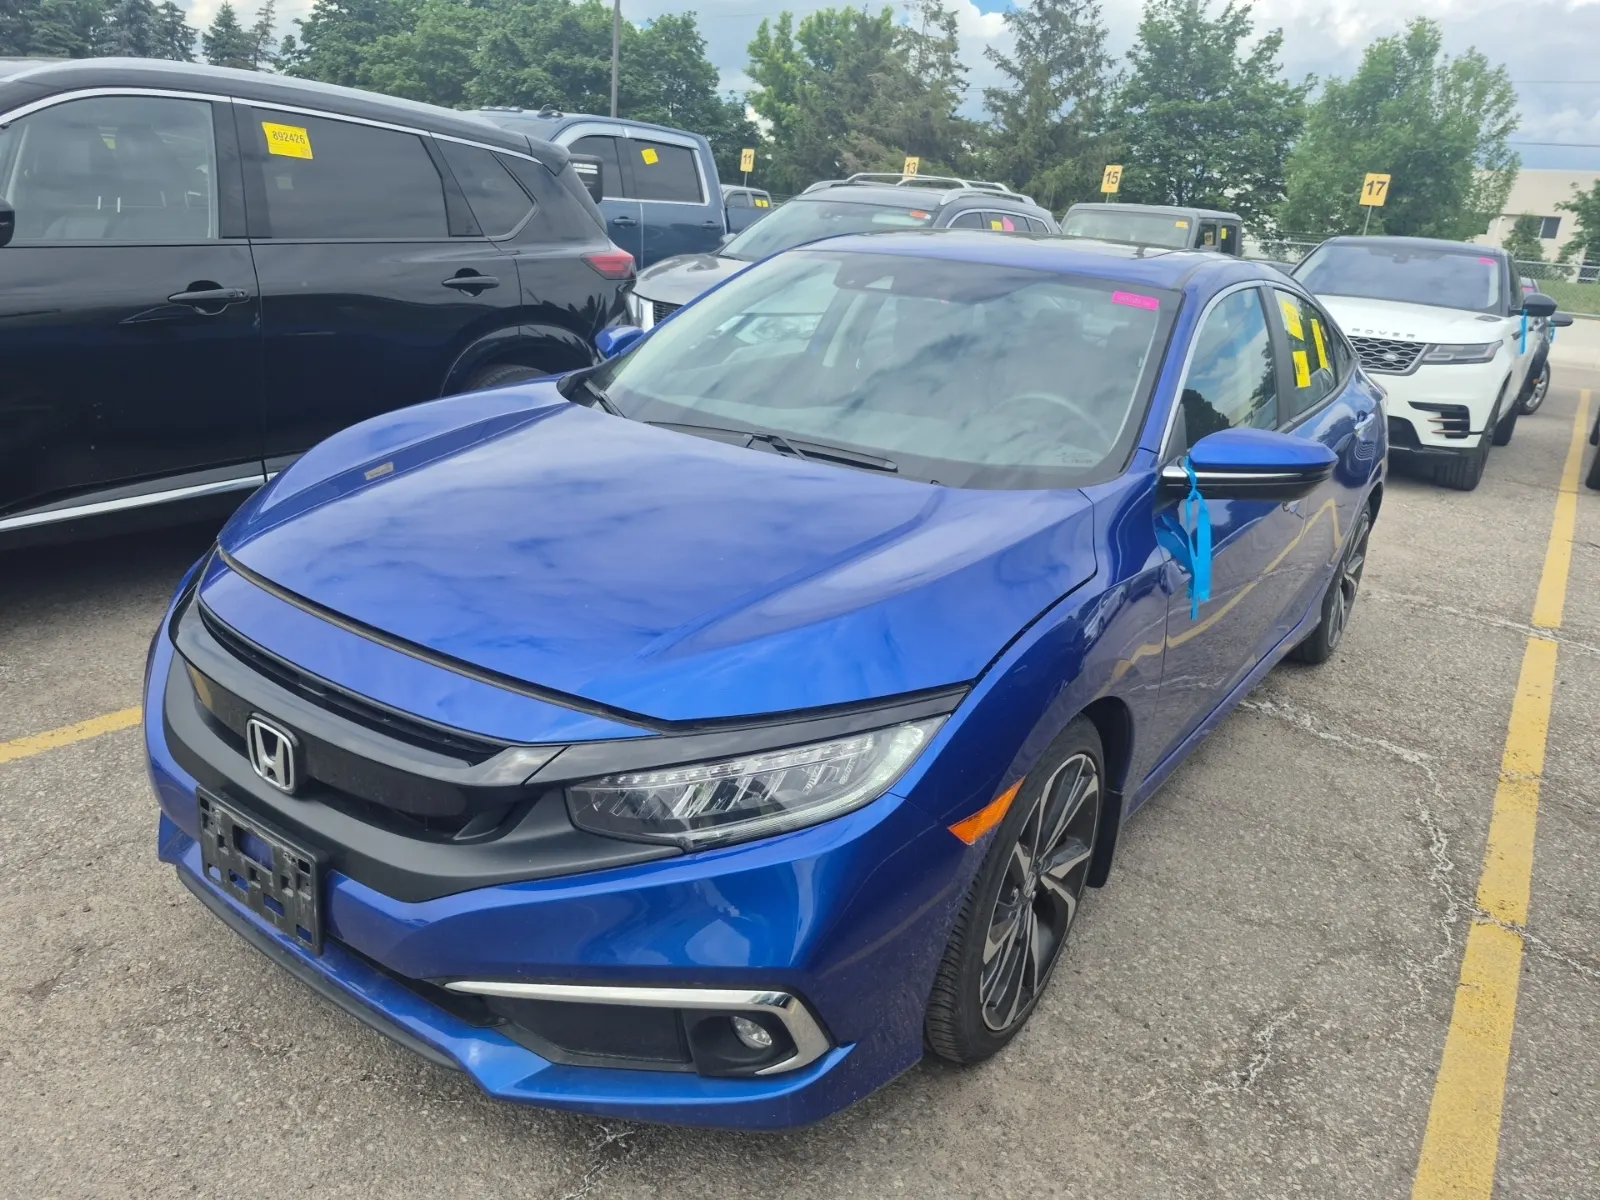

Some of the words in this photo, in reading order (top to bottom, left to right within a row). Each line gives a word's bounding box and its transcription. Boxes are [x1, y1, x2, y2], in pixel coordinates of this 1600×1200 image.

[743, 153, 752, 165] 11
[906, 162, 916, 175] 13
[1106, 171, 1119, 185] 15
[1366, 180, 1387, 196] 17
[1352, 327, 1415, 338] ROVER
